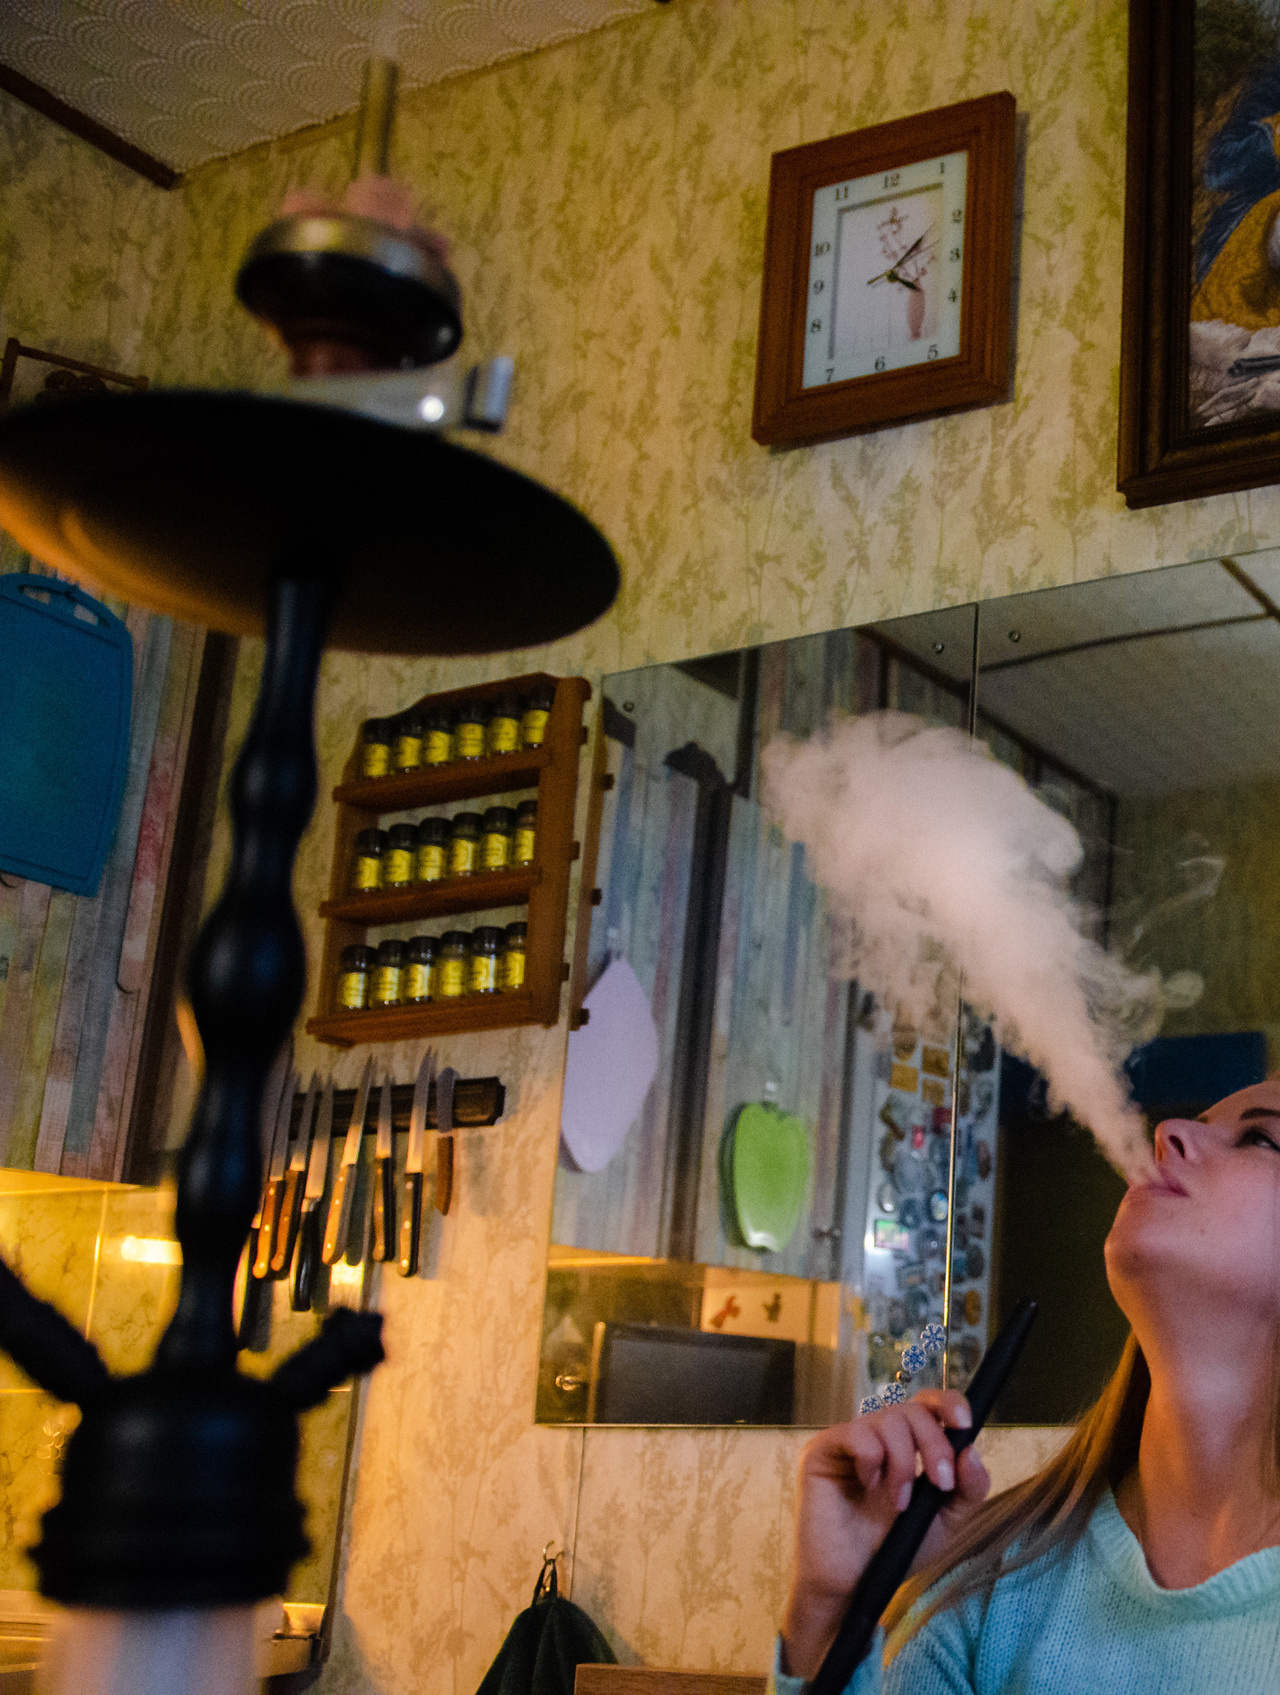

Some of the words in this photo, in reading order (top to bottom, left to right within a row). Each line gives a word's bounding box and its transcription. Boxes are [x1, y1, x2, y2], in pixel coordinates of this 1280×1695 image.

[938, 161, 945, 175] 1
[882, 173, 900, 189] 12
[834, 186, 850, 201] 11
[952, 209, 963, 223] 2
[814, 241, 831, 257] 10
[950, 247, 961, 262] 3
[813, 279, 825, 294] 9
[948, 289, 958, 303] 4
[810, 319, 822, 333] 8
[927, 344, 939, 360] 5
[874, 356, 886, 372] 6
[825, 368, 835, 383] 7
